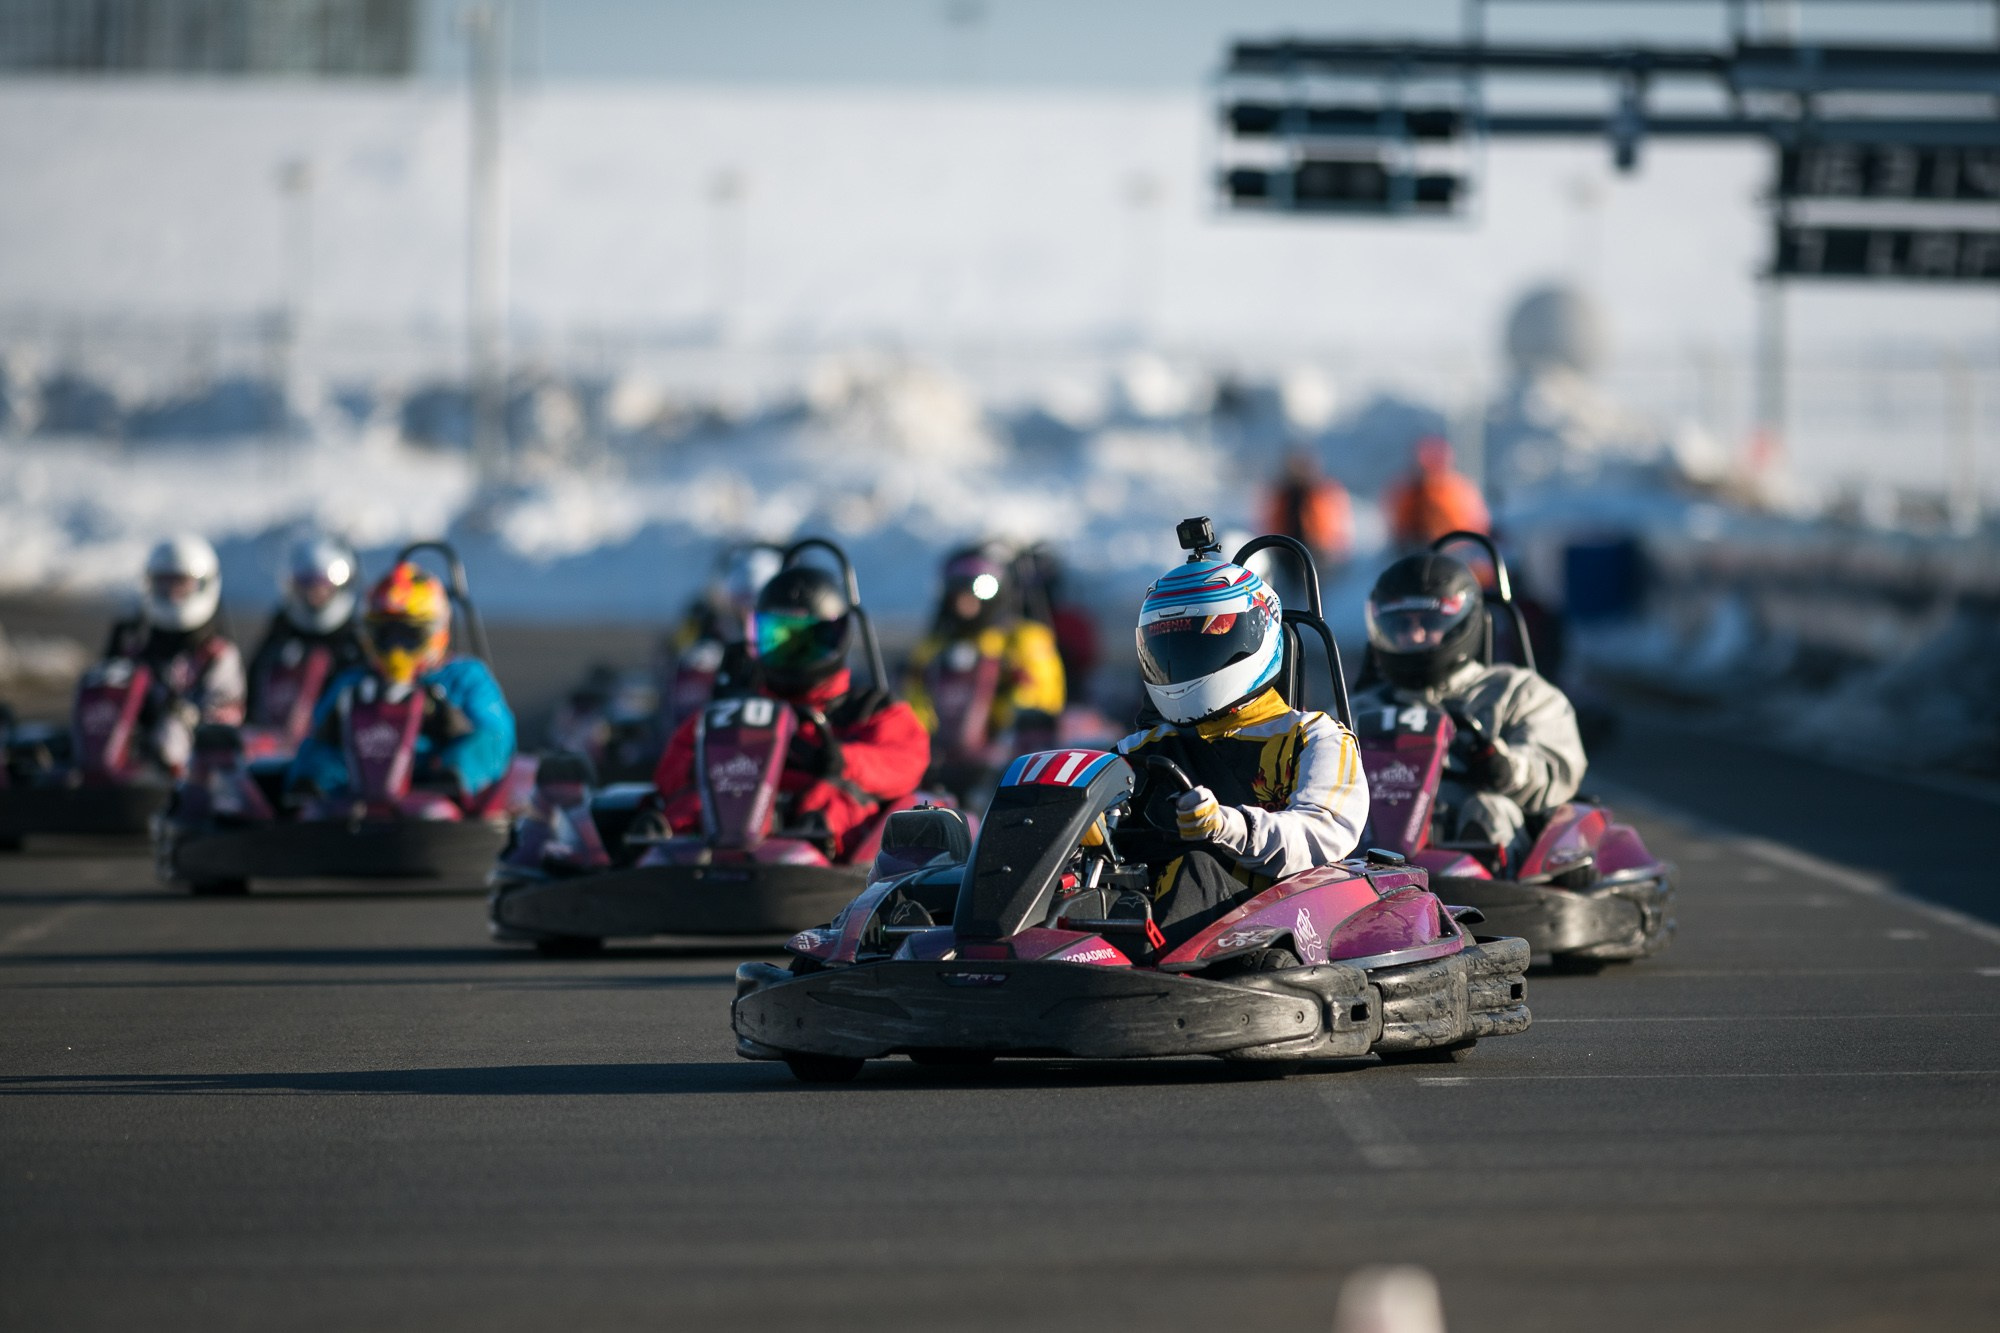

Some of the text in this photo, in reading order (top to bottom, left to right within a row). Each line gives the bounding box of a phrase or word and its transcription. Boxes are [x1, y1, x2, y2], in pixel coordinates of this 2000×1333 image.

[1149, 618, 1192, 632] PHOENIX
[1381, 706, 1428, 732] 14
[1022, 752, 1088, 783] 11
